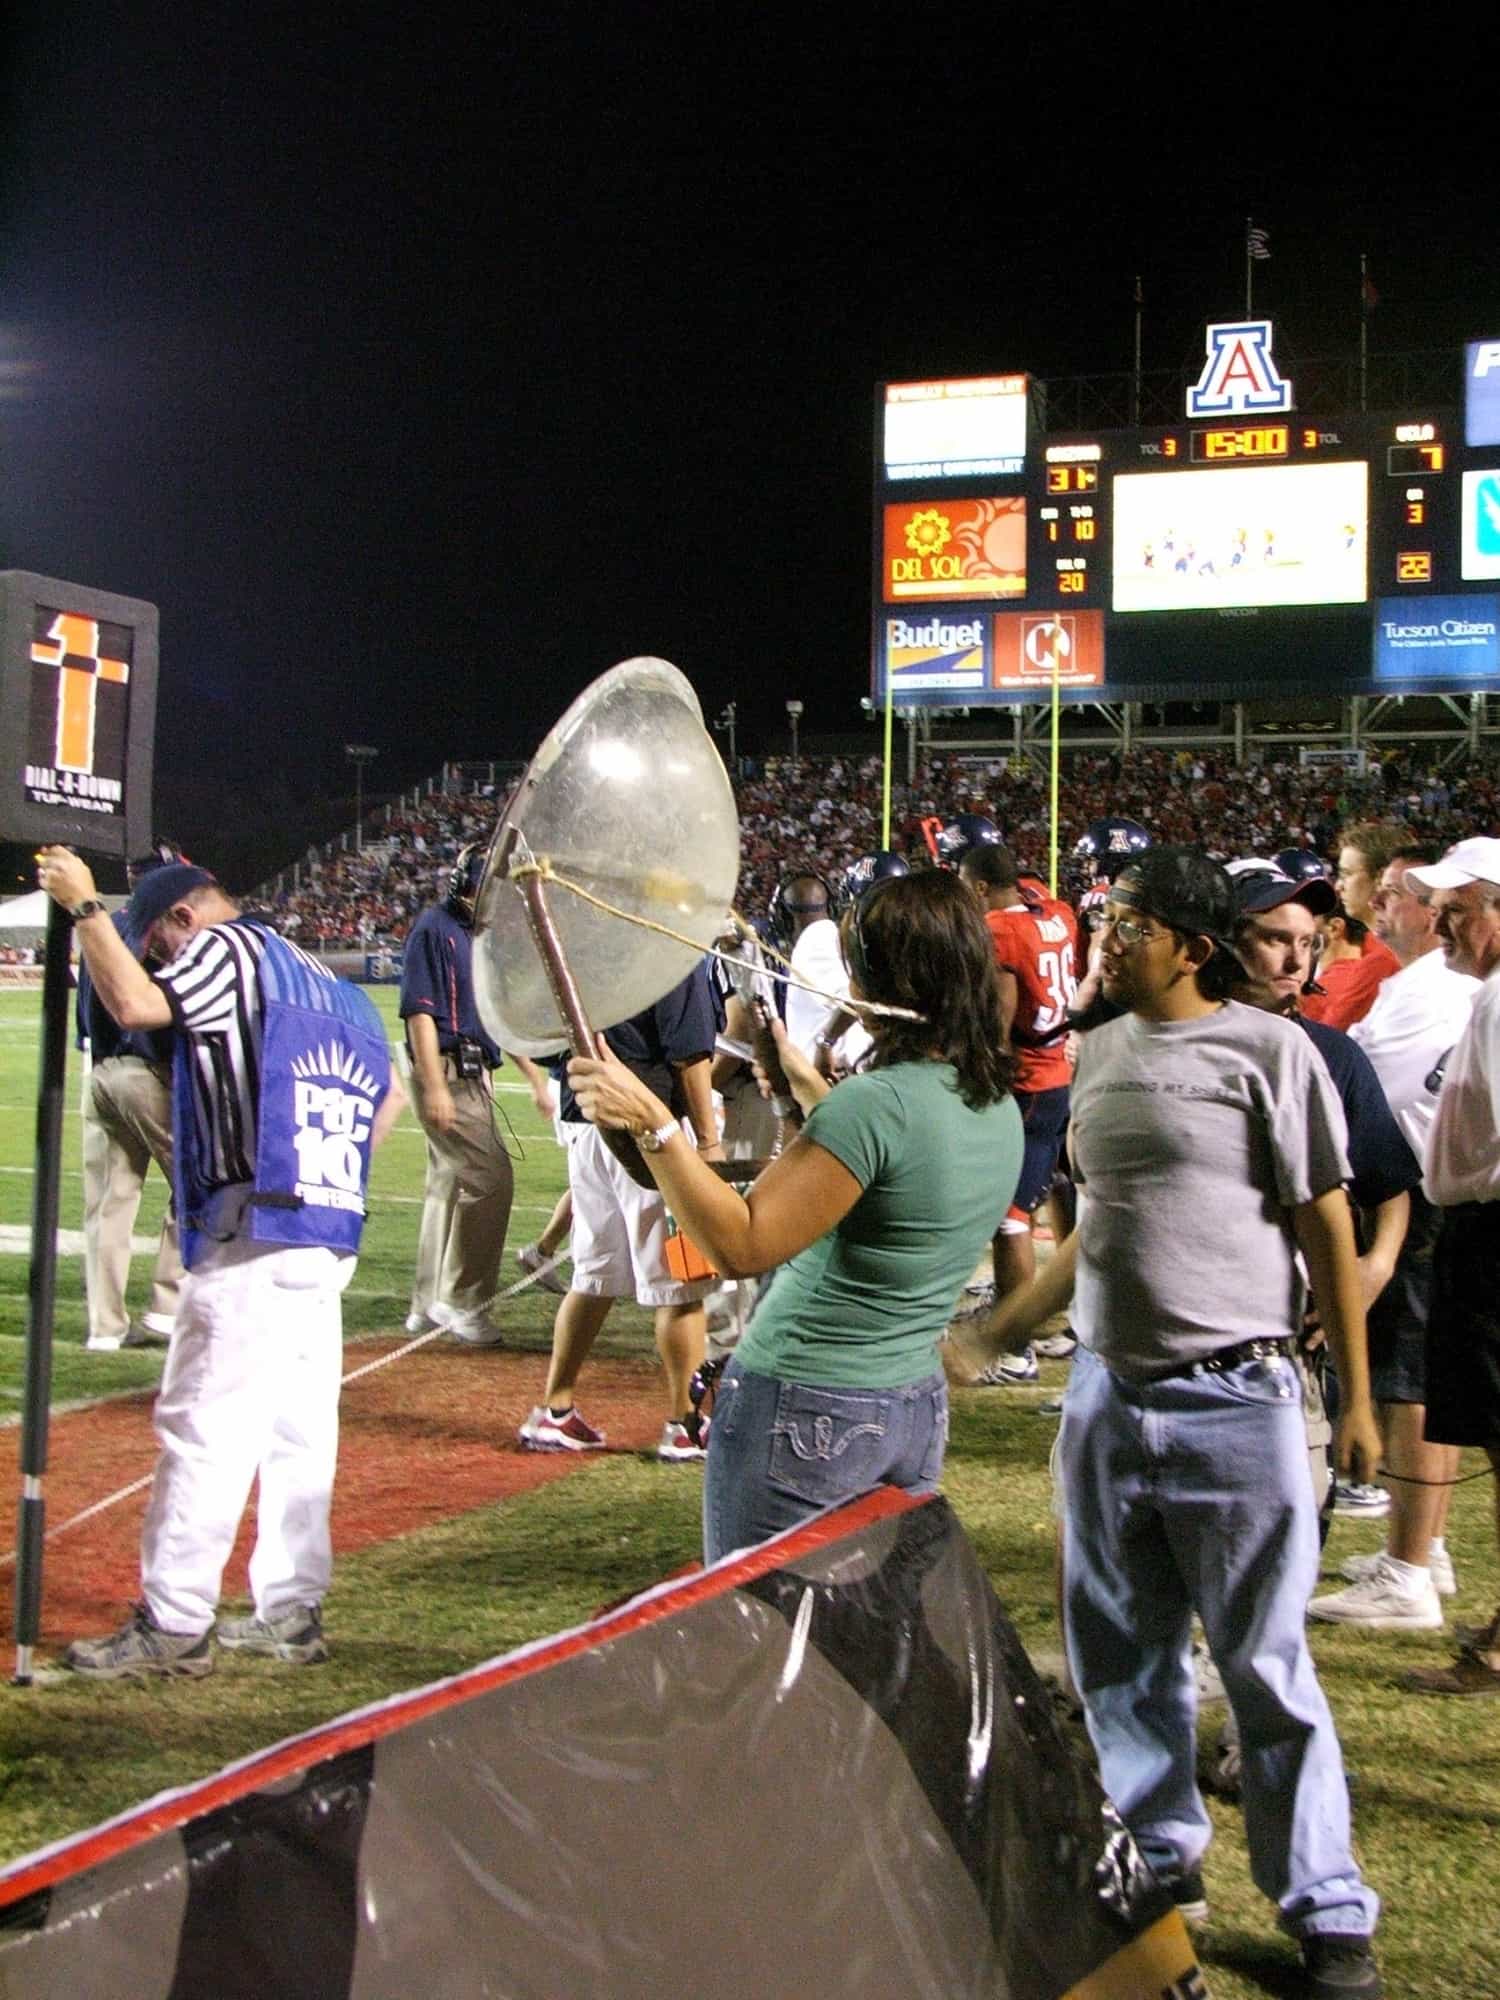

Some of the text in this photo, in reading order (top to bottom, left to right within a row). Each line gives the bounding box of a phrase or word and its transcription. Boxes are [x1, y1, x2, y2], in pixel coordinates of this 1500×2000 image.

[1187, 320, 1293, 418] A
[1163, 438, 1177, 457] 3
[1204, 428, 1288, 459] 15:00
[1303, 430, 1317, 448] 3
[1407, 503, 1424, 524] 3
[1048, 522, 1058, 542] 1
[891, 555, 963, 581] DEL SOL
[1058, 572, 1086, 593] 20
[888, 617, 984, 655] Budget
[1382, 619, 1497, 639] Tucson Citizen
[47, 611, 99, 775] 1
